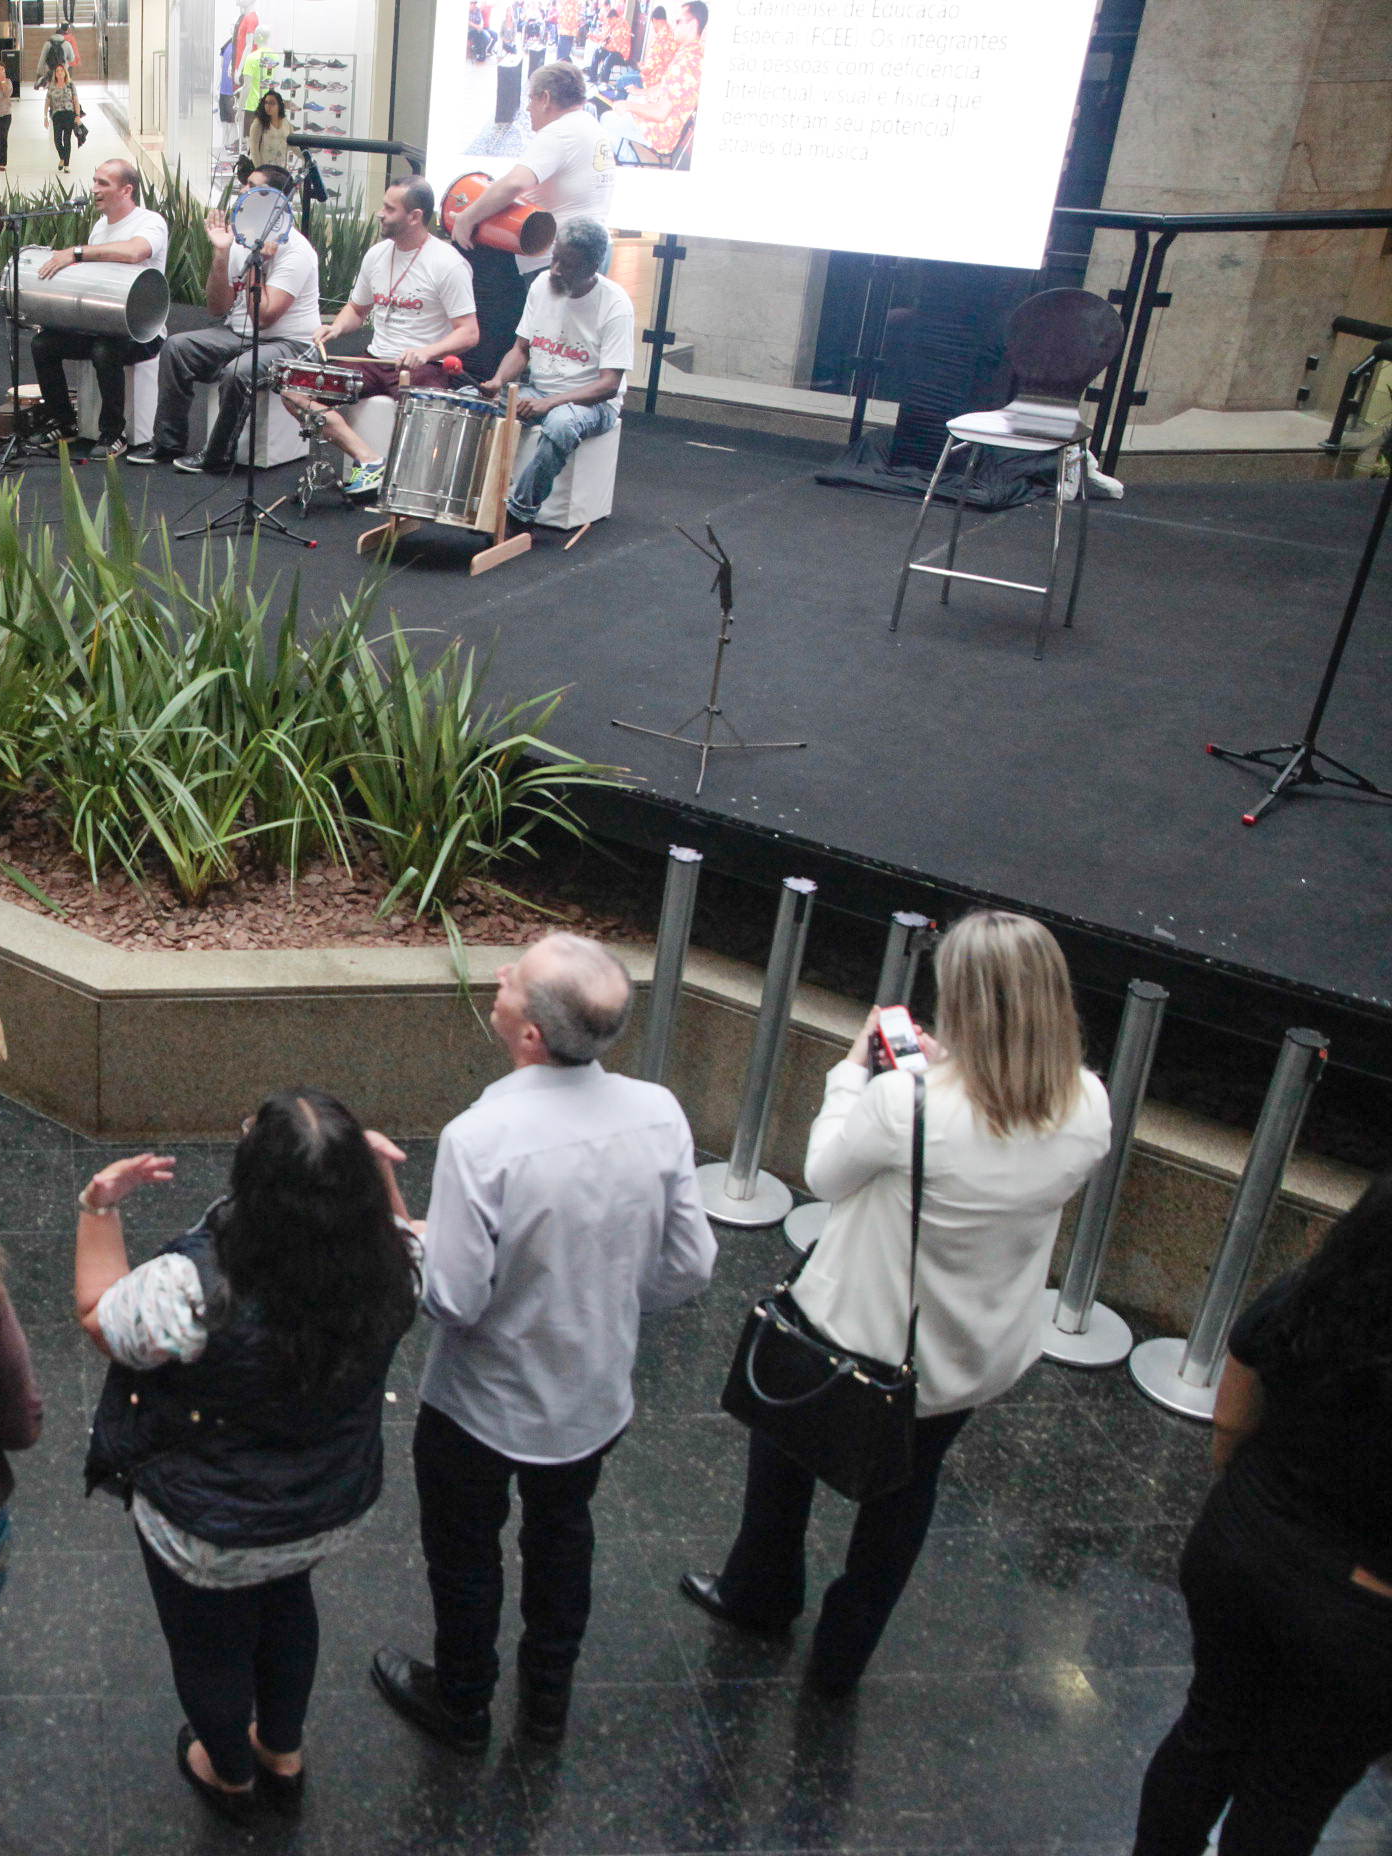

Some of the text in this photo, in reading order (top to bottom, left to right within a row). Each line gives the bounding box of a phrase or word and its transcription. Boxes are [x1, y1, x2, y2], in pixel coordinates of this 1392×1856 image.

[843, 0, 865, 18] de
[733, 25, 800, 49] Especial
[871, 28, 894, 47] Os
[900, 28, 1008, 55] integrantes
[729, 53, 980, 79] são pessoas com deficiência
[725, 80, 816, 104] Intelectual,
[822, 84, 872, 104] visual
[878, 91, 888, 106] e
[946, 94, 982, 114] que
[722, 106, 956, 138] demonstram seu potencial
[781, 137, 802, 156] da
